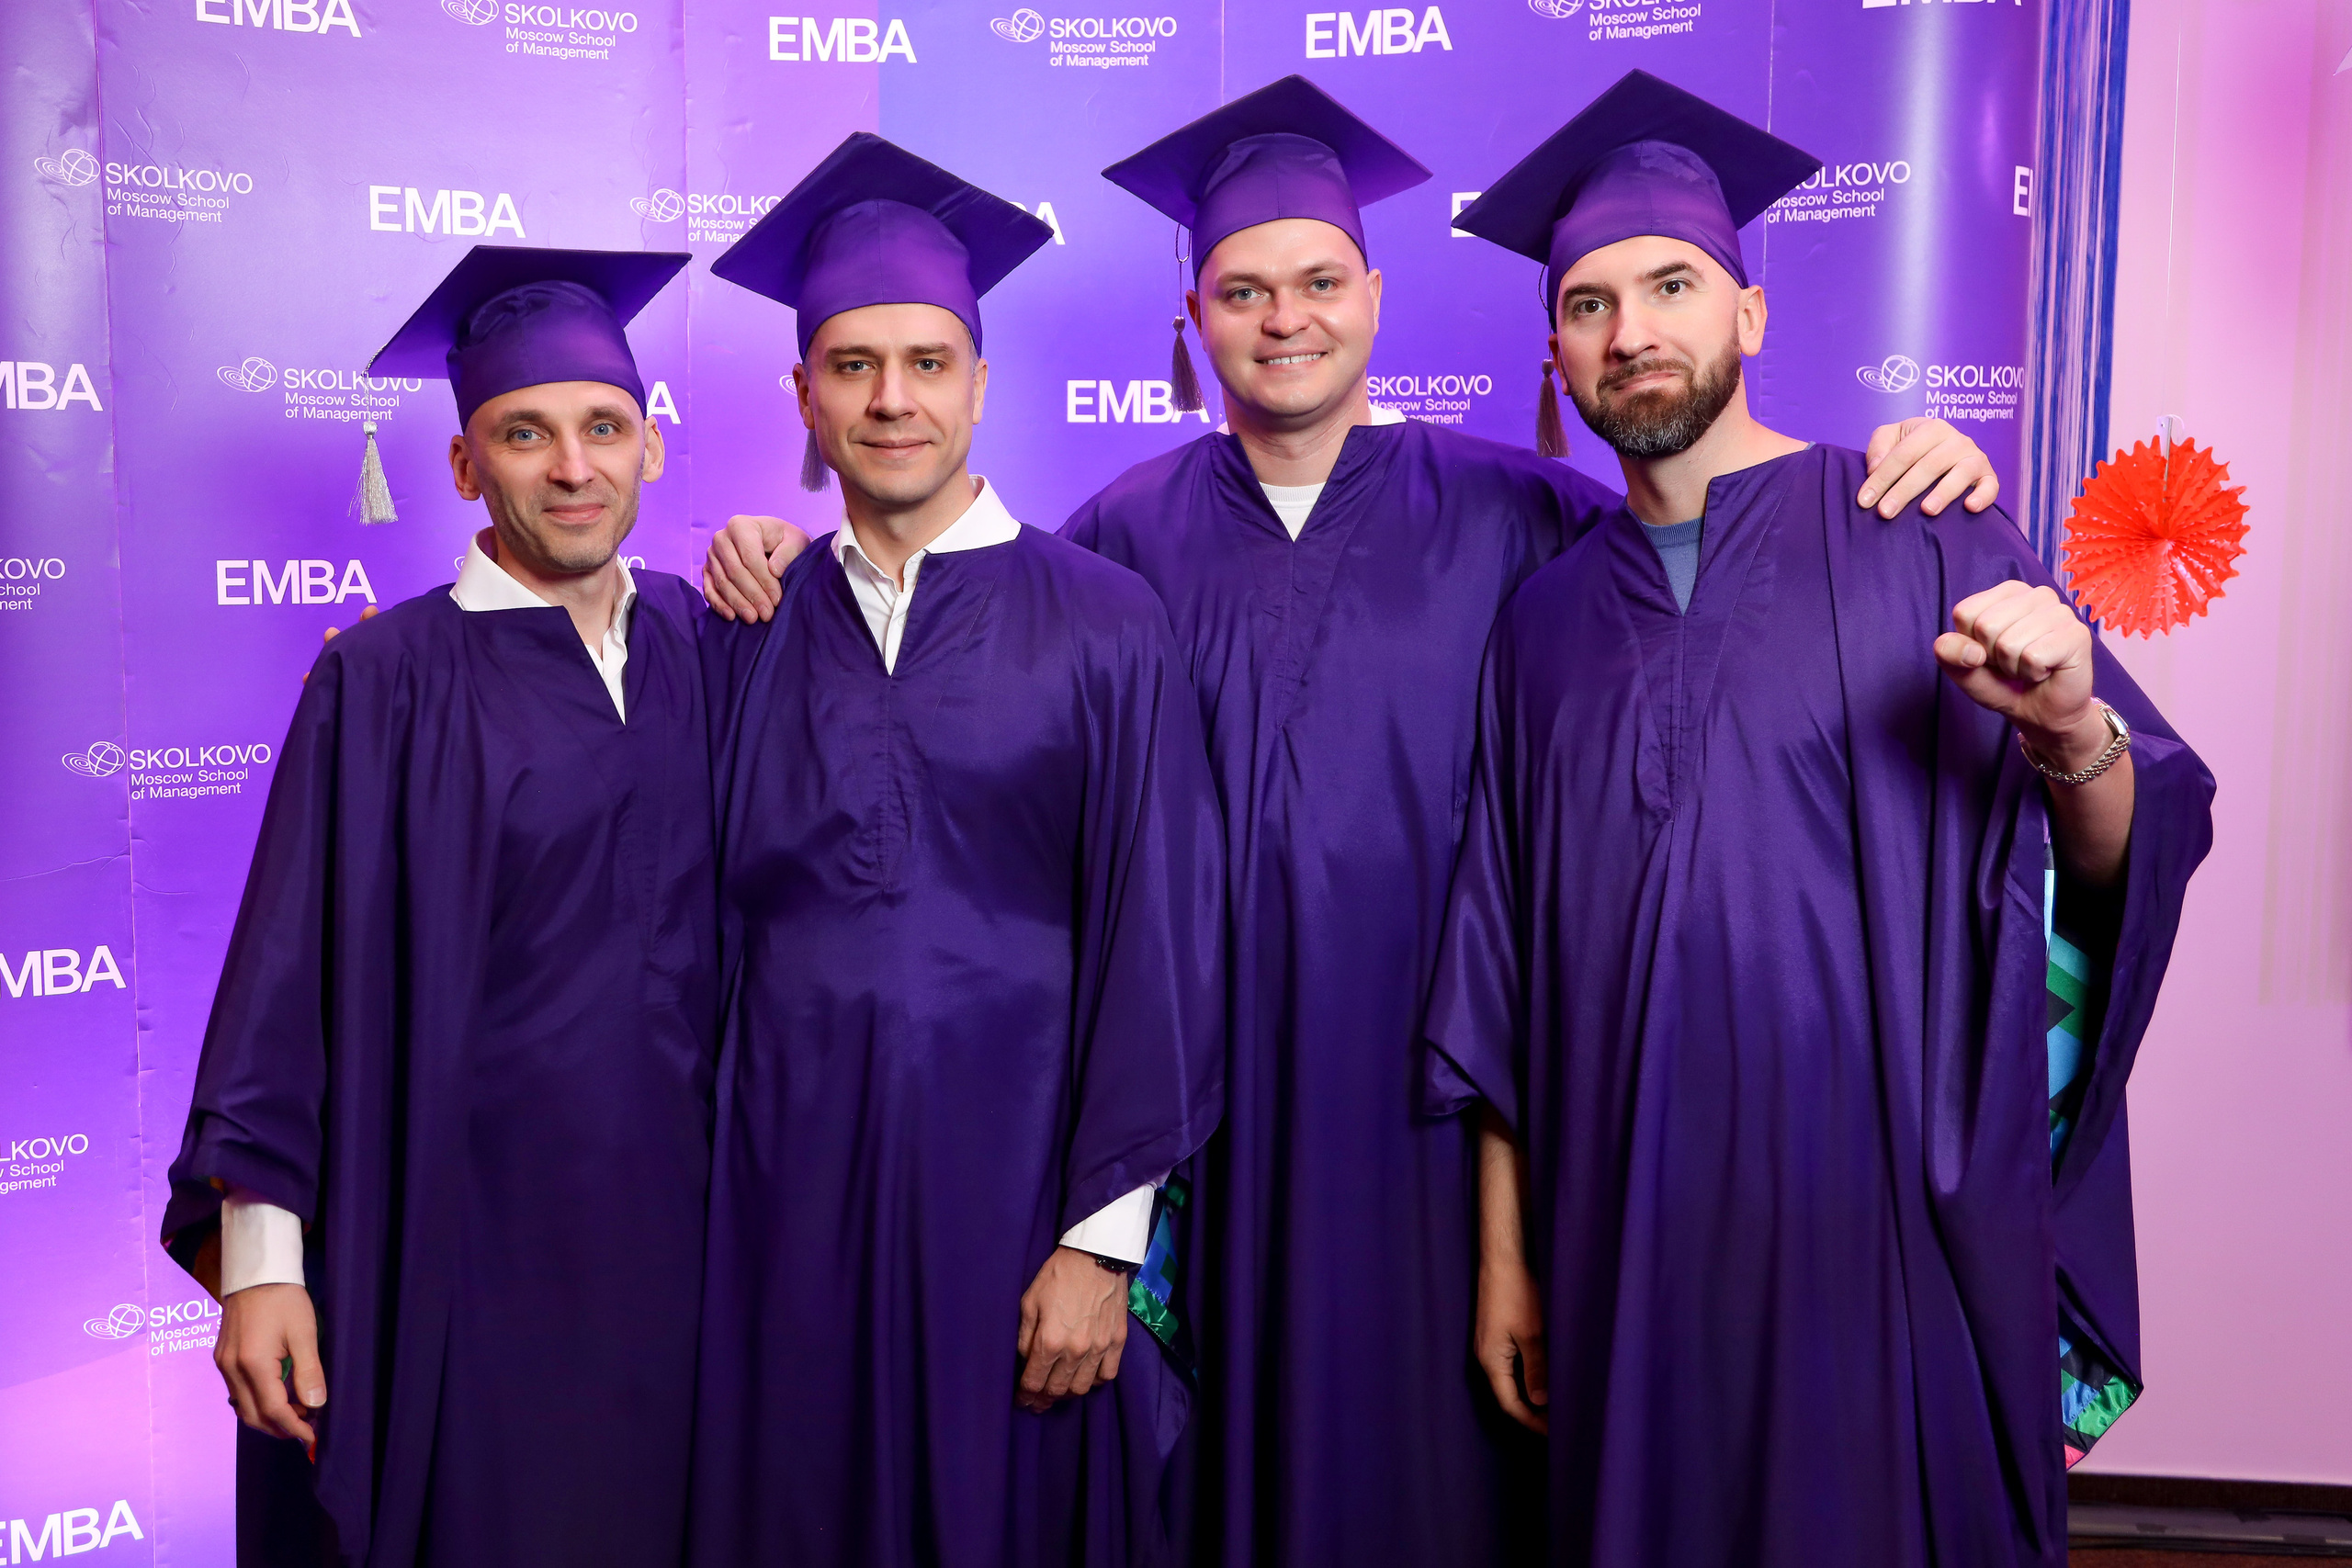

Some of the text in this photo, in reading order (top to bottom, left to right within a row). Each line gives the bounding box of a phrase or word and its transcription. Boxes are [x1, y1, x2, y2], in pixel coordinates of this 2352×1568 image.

[504, 3, 638, 32] SKOLKOVO
[1589, 11, 1648, 27] Moscow
[1652, 3, 1701, 21] School
[506, 27, 616, 47] Moscow School
[1049, 17, 1177, 39] SKOLKOVO
[1306, 6, 1453, 59] EMBA
[1589, 19, 1693, 41] of Management
[769, 17, 918, 63] EMBA
[1050, 40, 1156, 53] Moscow School
[505, 41, 609, 60] of Management
[1050, 53, 1148, 69] of Management
[106, 162, 254, 195] SKOLKOVO
[1795, 161, 1911, 190] OLKOVO
[107, 187, 230, 209] Moscow School
[1832, 187, 1884, 204] School
[107, 203, 222, 223] of Management
[369, 185, 526, 239] EMBA
[1767, 204, 1876, 223] of Management
[688, 217, 744, 230] Moscow
[688, 230, 701, 242] of
[1366, 375, 1493, 396] SKOLKOVO
[1926, 365, 2025, 389] SKOLKOVO
[285, 392, 400, 407] Moscow School
[1425, 398, 1471, 412] School
[1926, 390, 2018, 405] Moscow School
[286, 406, 392, 423] of Management
[1925, 405, 2014, 423] of Management
[216, 559, 378, 605] EMBA
[130, 743, 272, 771] SKOLKOVO
[131, 768, 249, 786] Moscow School
[131, 783, 242, 800] of Management
[9, 1159, 64, 1177] School
[151, 1323, 211, 1343] Moscow
[151, 1342, 165, 1356] of
[0, 1499, 144, 1566] MBA
